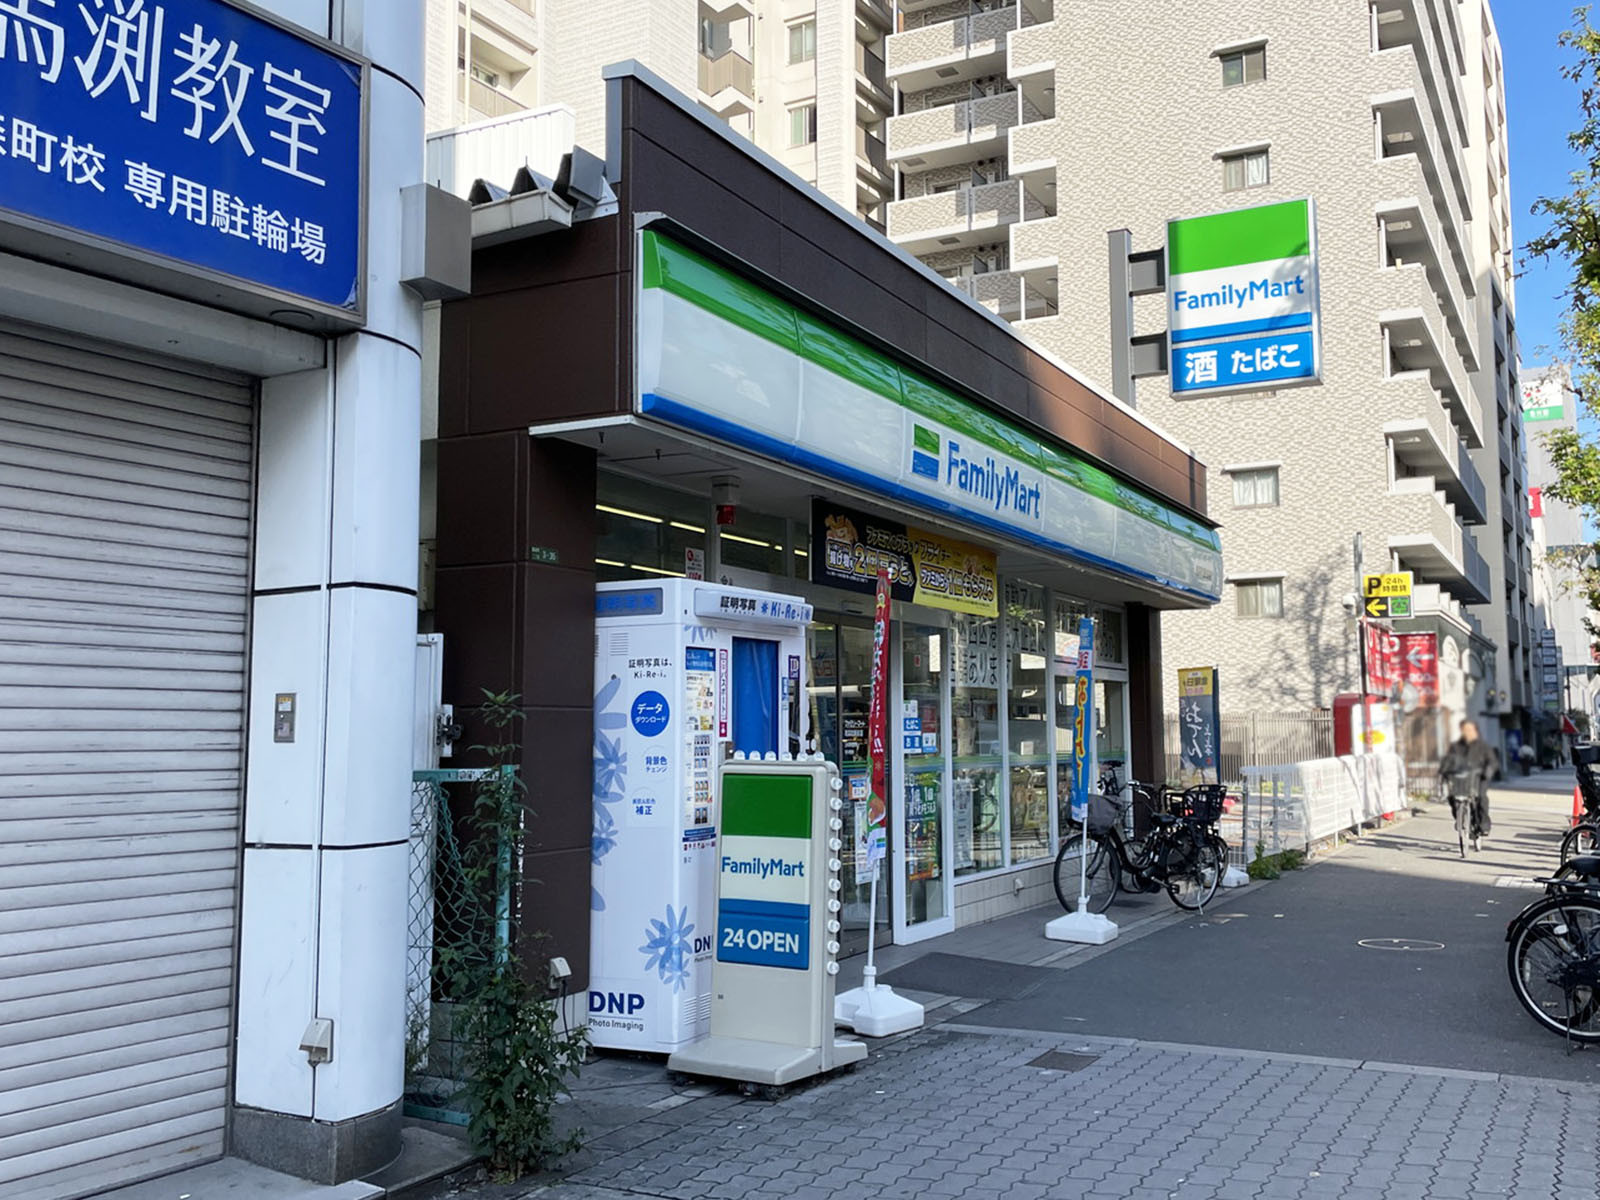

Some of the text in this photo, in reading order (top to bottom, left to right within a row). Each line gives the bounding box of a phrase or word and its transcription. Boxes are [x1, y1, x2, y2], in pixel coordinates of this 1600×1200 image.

[0, 114, 327, 265] 町校 専用駐輪場
[1174, 275, 1305, 311] FamilyMart
[1185, 344, 1301, 384] 酒 たばこ
[947, 440, 1041, 519] FamilyMart
[1367, 577, 1382, 595] P
[720, 596, 757, 611] 証明写真
[635, 716, 666, 724] ダウンロード
[637, 703, 663, 714] データ
[721, 856, 805, 880] FamilyMart
[695, 935, 713, 954] DN
[723, 927, 800, 954] 24 OPEN
[589, 991, 645, 1015] DNP
[588, 1018, 644, 1032] Photo Imaging
